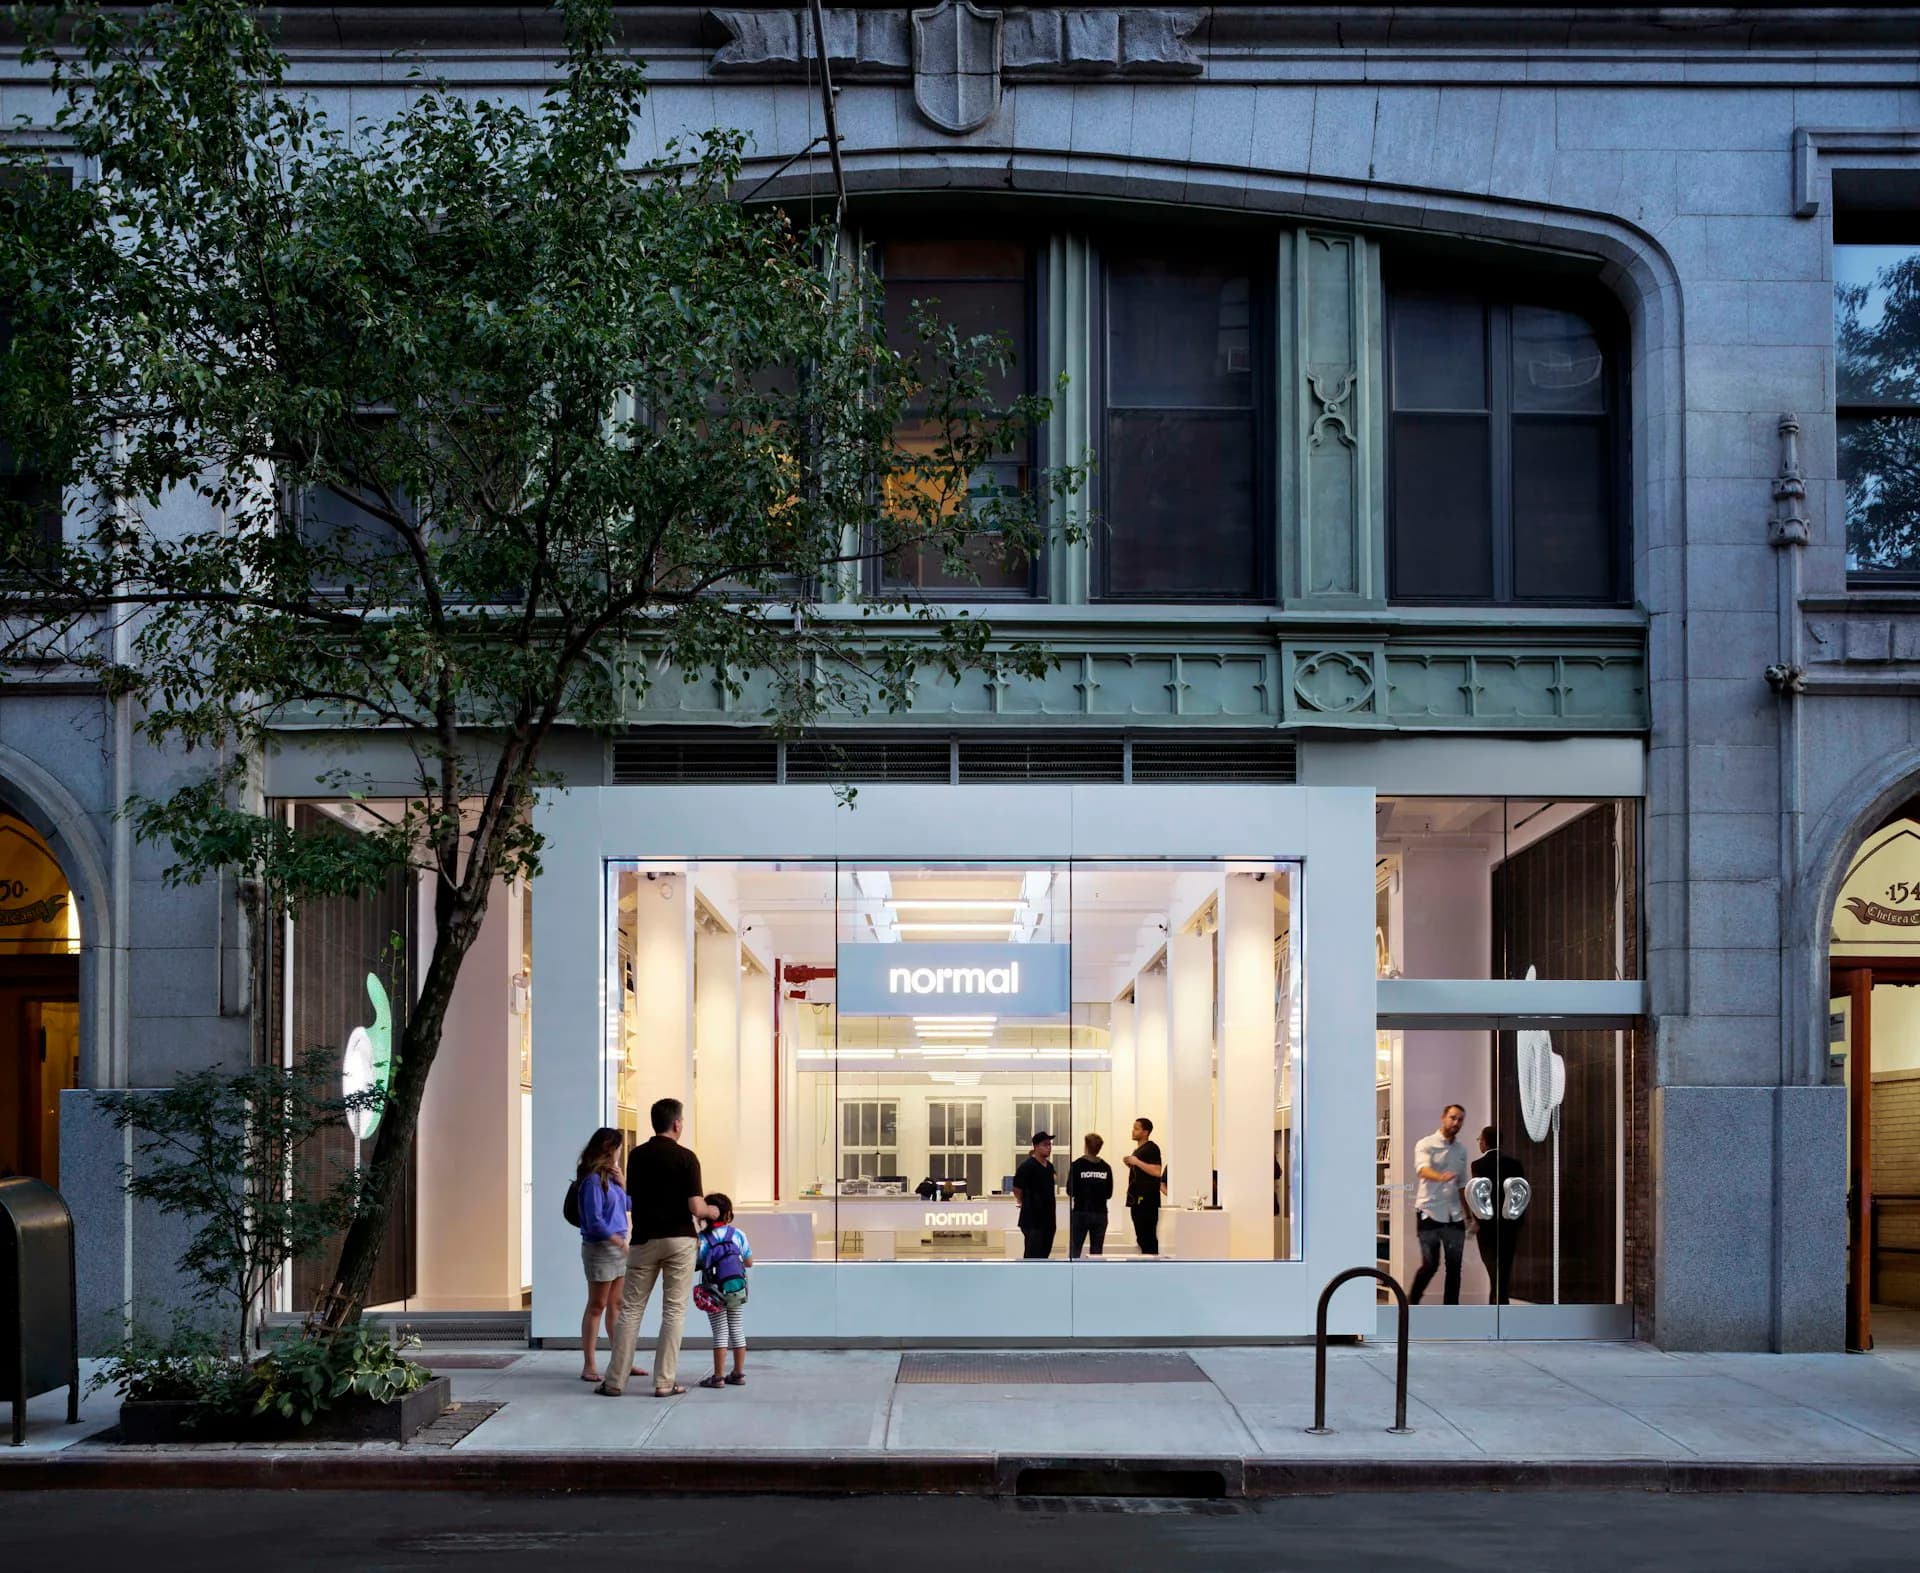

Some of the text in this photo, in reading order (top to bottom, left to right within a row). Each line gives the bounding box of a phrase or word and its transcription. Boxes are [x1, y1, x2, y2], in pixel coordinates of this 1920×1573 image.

[1867, 906, 1908, 924] Chelsea
[889, 961, 1019, 994] normal
[1080, 1171, 1107, 1179] normal
[925, 1209, 988, 1226] normal
